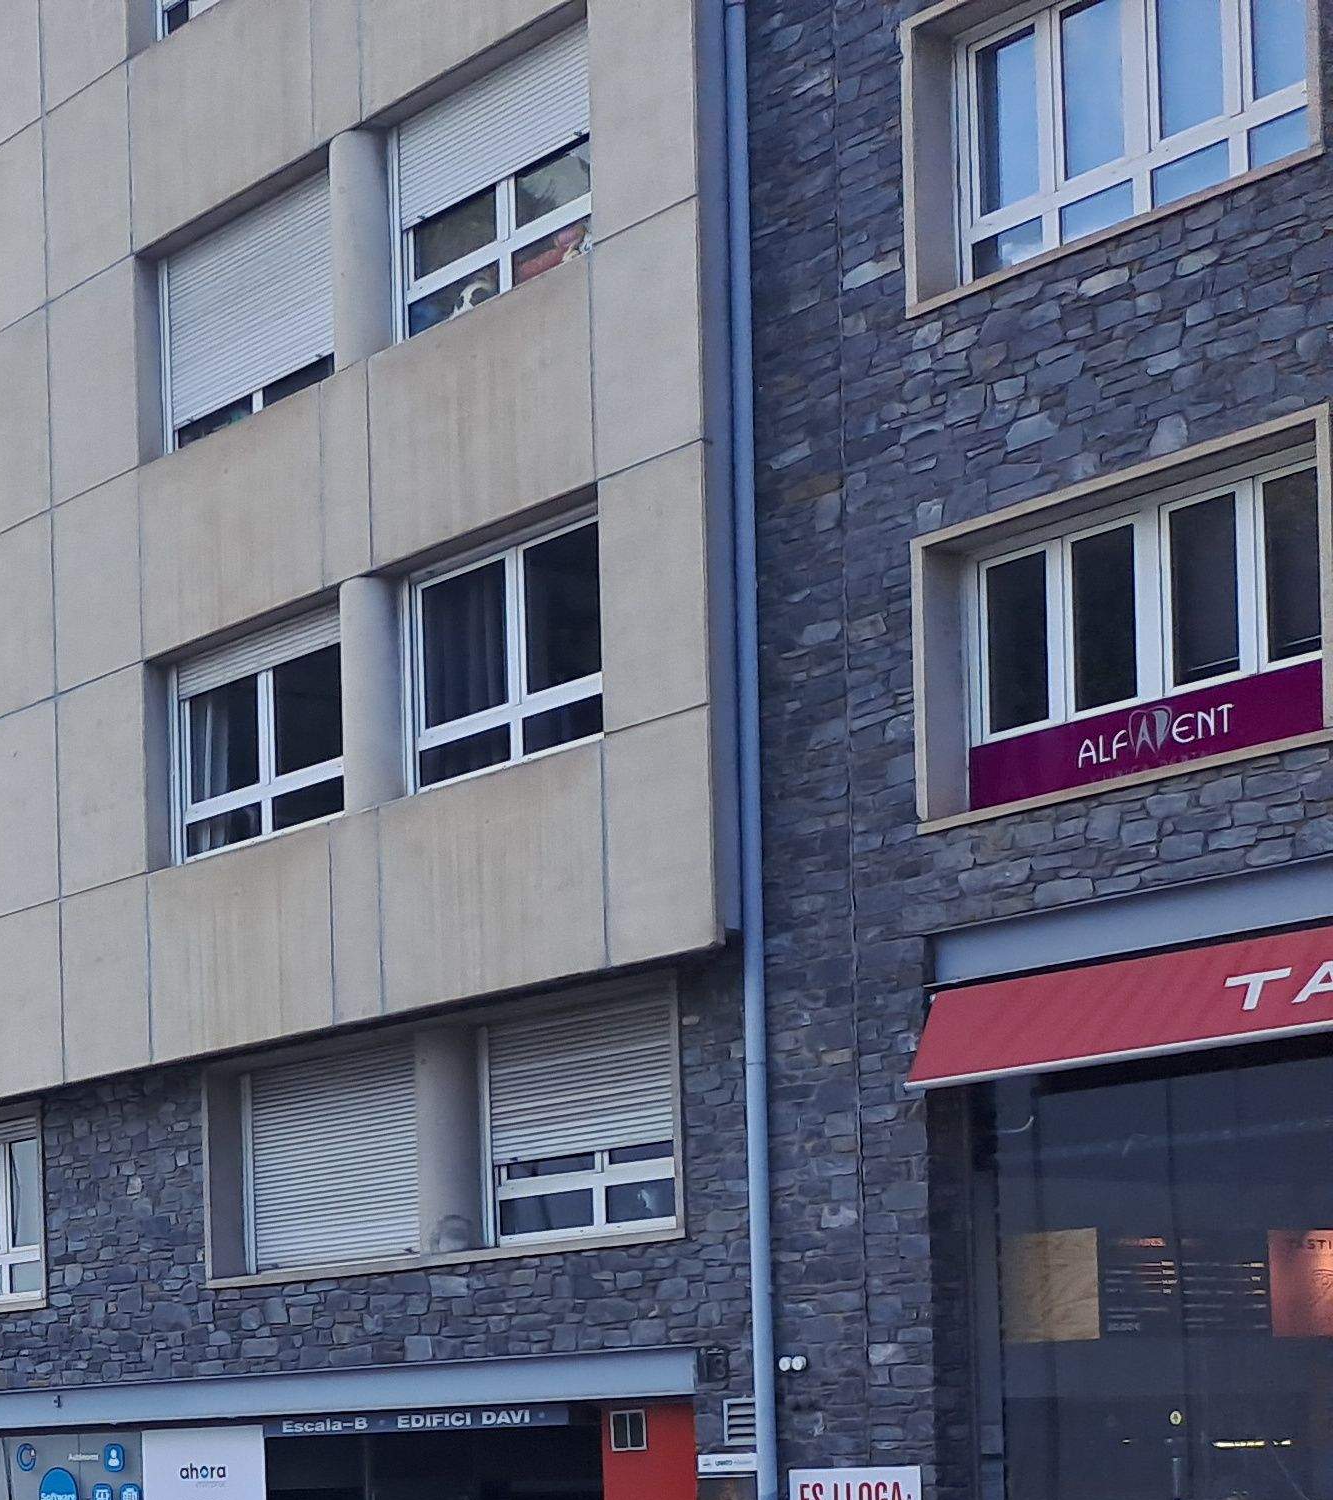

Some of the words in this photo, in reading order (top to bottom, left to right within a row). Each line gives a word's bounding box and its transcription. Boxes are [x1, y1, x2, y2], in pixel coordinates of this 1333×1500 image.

[282, 1416, 369, 1434] Escala-B
[397, 1411, 472, 1429] EDIFICI
[482, 1409, 531, 1426] DAVI
[179, 1463, 226, 1479] ahora
